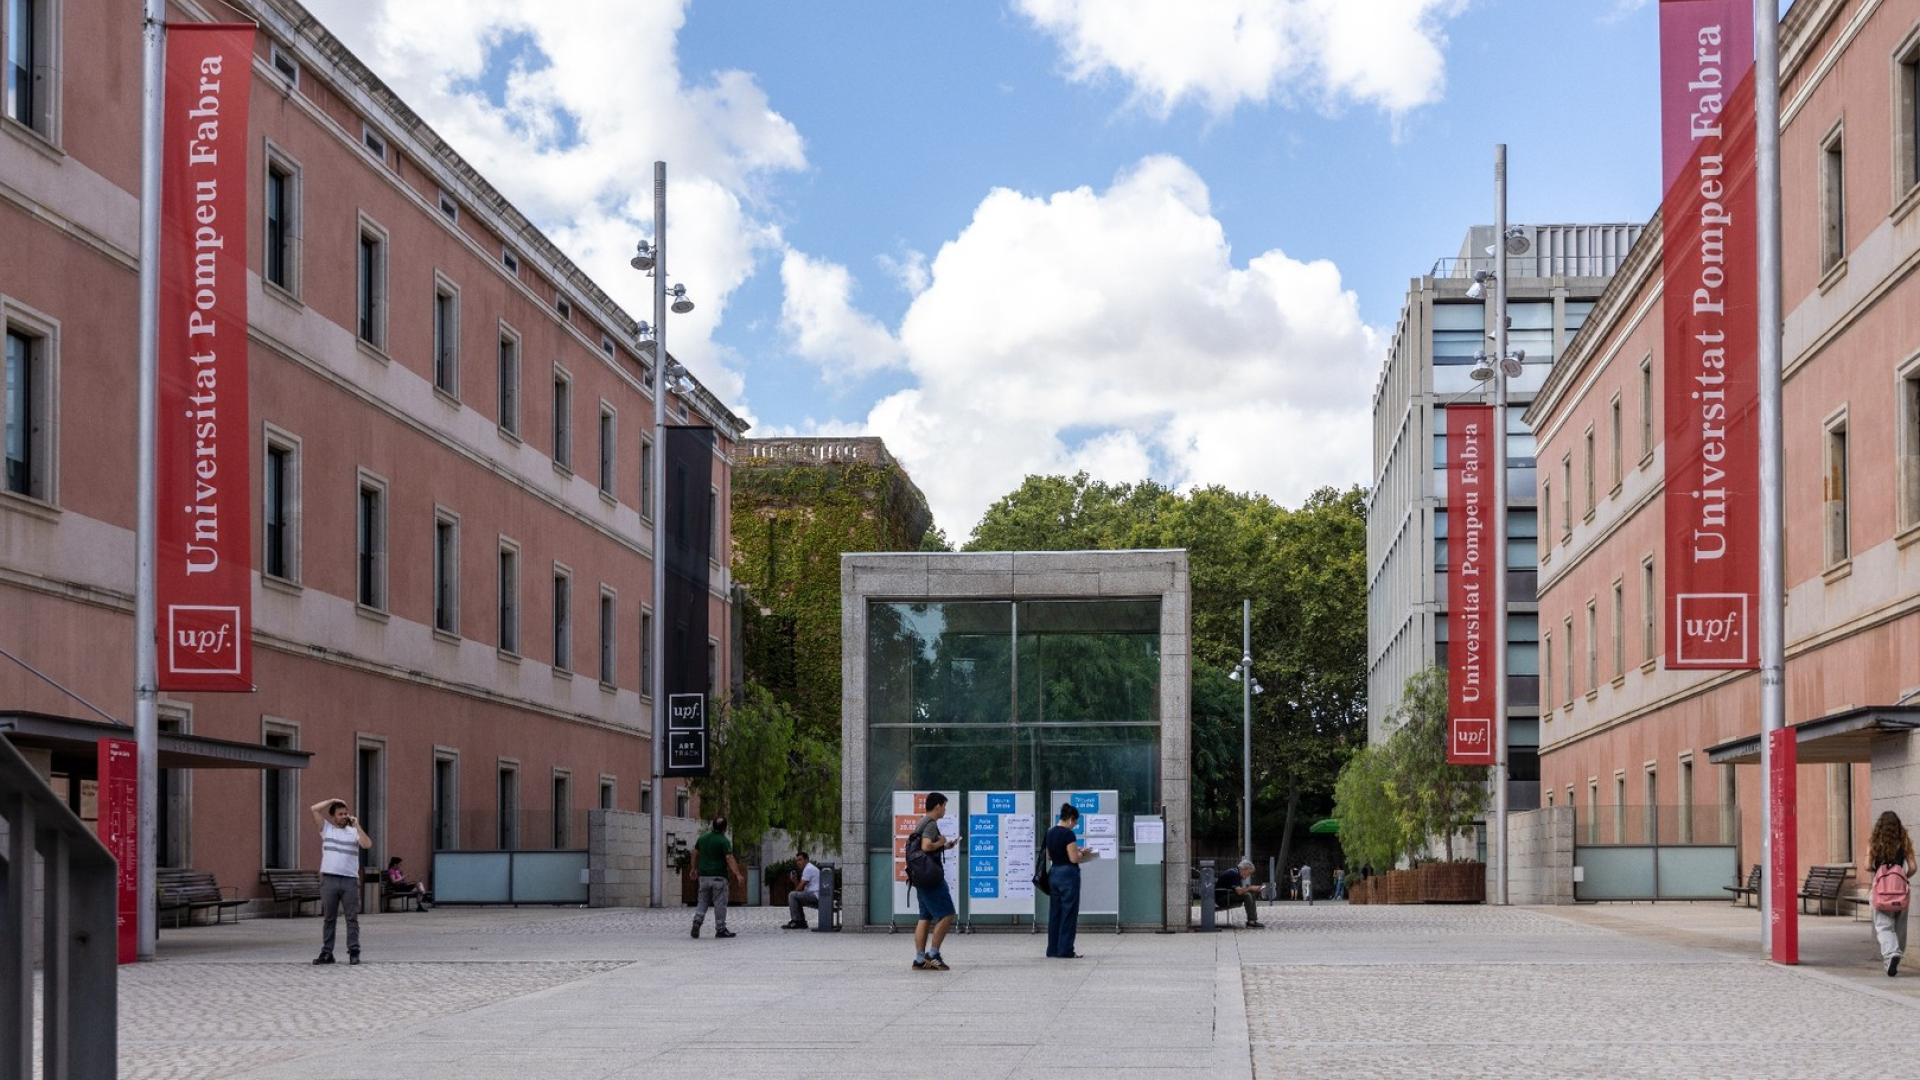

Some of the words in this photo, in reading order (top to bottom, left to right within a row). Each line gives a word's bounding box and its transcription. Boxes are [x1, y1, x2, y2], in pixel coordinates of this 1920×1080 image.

[189, 54, 222, 167] Fabra
[1688, 25, 1722, 141] Fabra
[190, 179, 223, 338] Pompeu
[1694, 154, 1731, 316] Pompeu
[185, 350, 217, 576] Universitat
[1460, 423, 1478, 485] Fabra
[1692, 330, 1725, 563] Universitat
[1462, 492, 1483, 576] Pompeu
[178, 623, 231, 653] upf.
[1462, 583, 1480, 703] Universitat
[1685, 611, 1738, 643] upf.
[673, 702, 700, 719] upf.
[678, 742, 695, 750] ART
[1458, 728, 1486, 746] upf.
